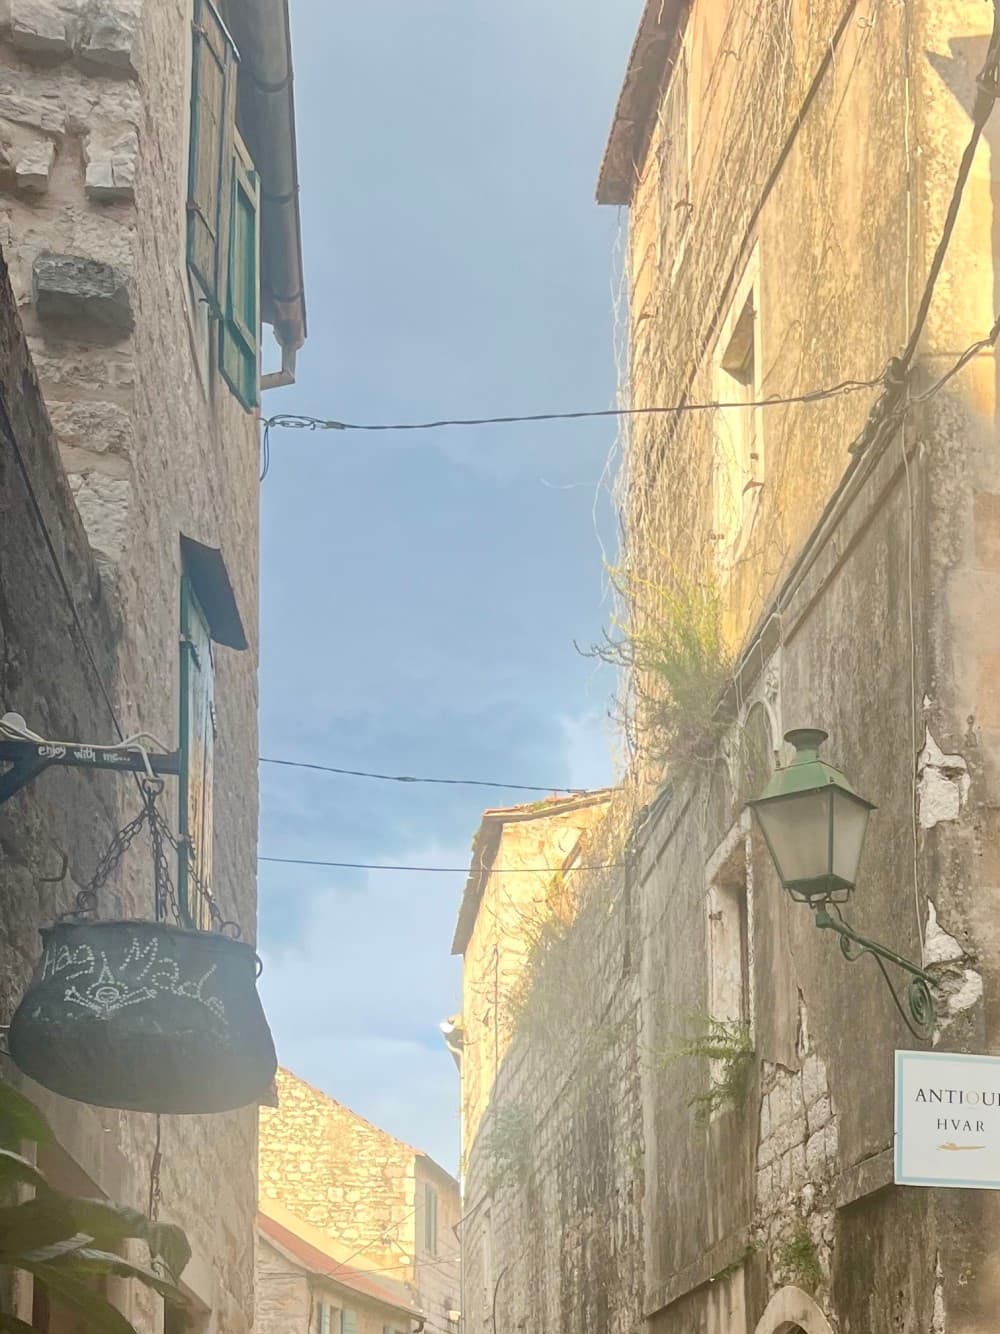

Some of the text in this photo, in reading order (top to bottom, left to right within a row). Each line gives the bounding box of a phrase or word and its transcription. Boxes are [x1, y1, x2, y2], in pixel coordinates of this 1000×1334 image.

[37, 744, 67, 759] enjoy
[74, 746, 96, 762] with
[936, 1118, 985, 1133] HVAR
